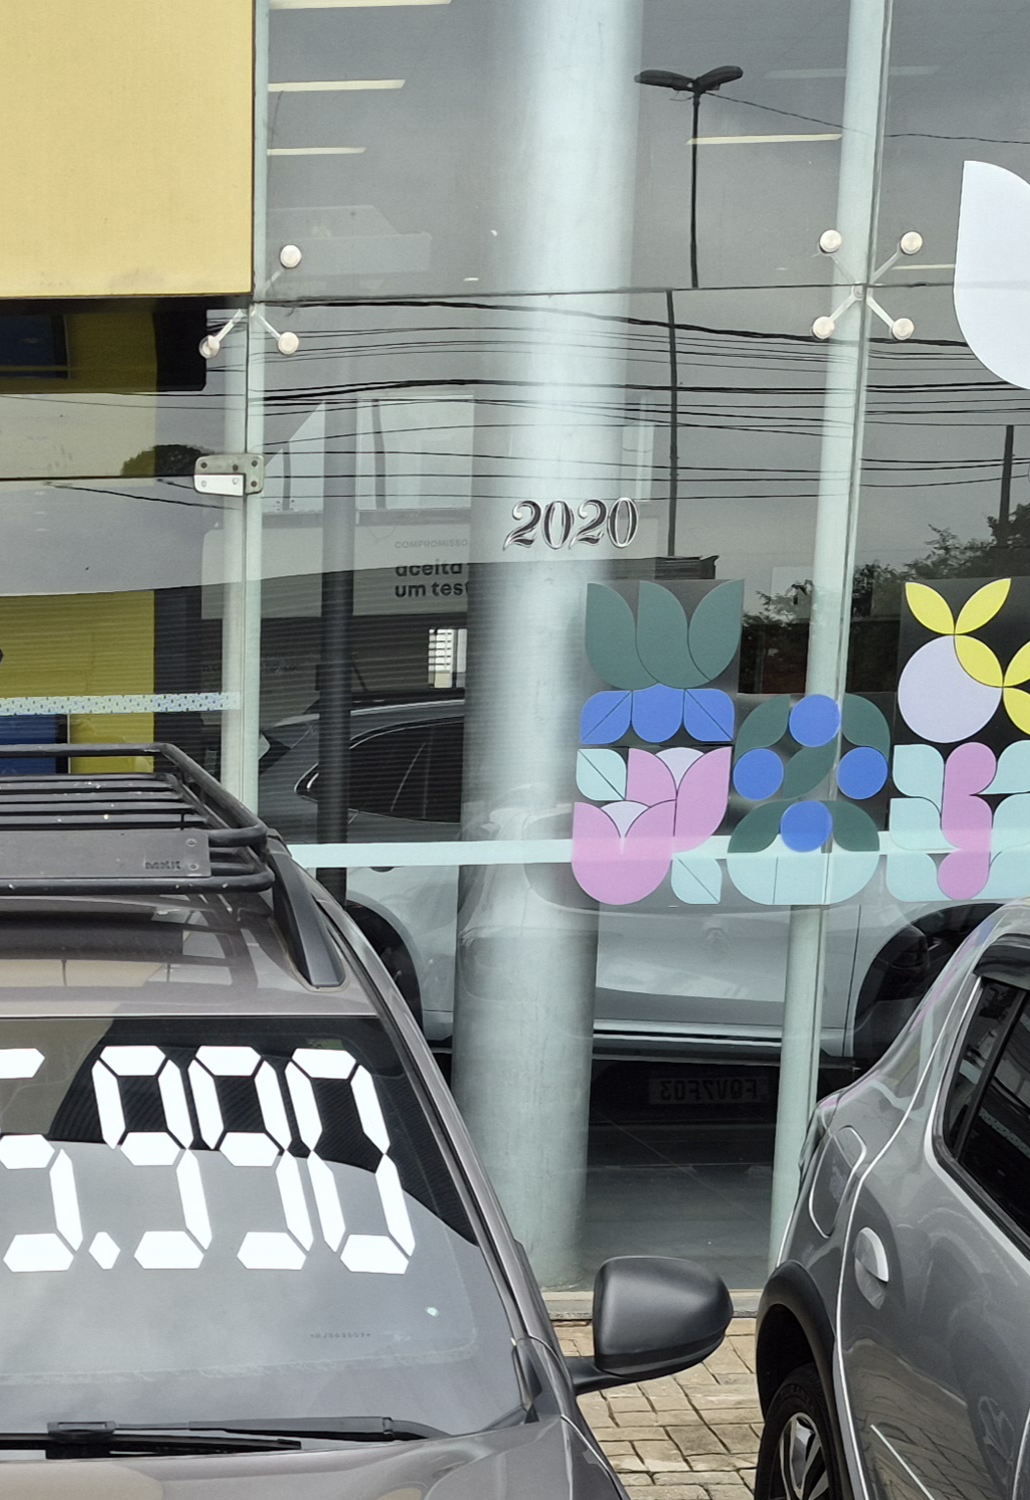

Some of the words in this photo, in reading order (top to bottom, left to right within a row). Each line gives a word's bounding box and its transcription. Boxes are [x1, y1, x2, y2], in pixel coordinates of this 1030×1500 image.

[502, 497, 639, 551] 2020
[394, 538, 469, 549] COMPROMISSO
[394, 559, 463, 577] aceita
[394, 582, 427, 598] um
